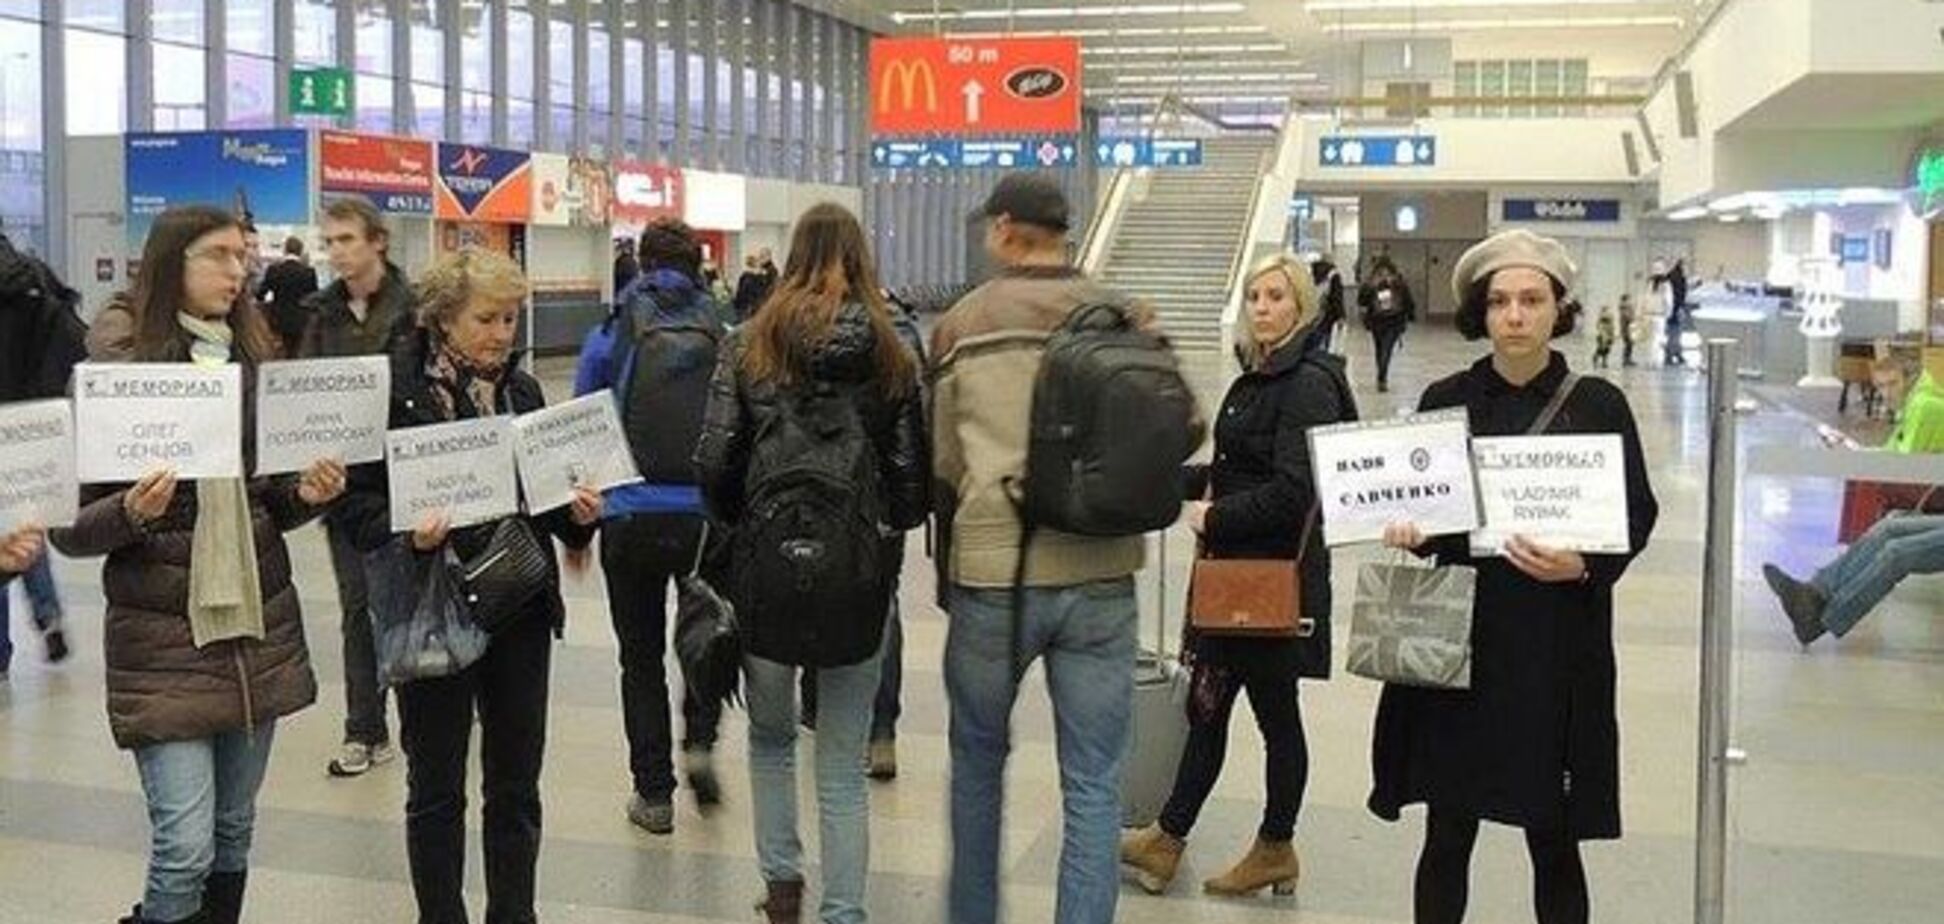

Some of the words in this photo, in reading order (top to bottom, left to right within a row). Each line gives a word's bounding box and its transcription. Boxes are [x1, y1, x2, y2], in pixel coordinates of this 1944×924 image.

[114, 379, 224, 398] МЕМОРИАЛ
[131, 422, 179, 439] ОЛЕГ
[116, 440, 193, 461] СЕНЦОВ
[1338, 481, 1451, 508] САВЧЕНКО
